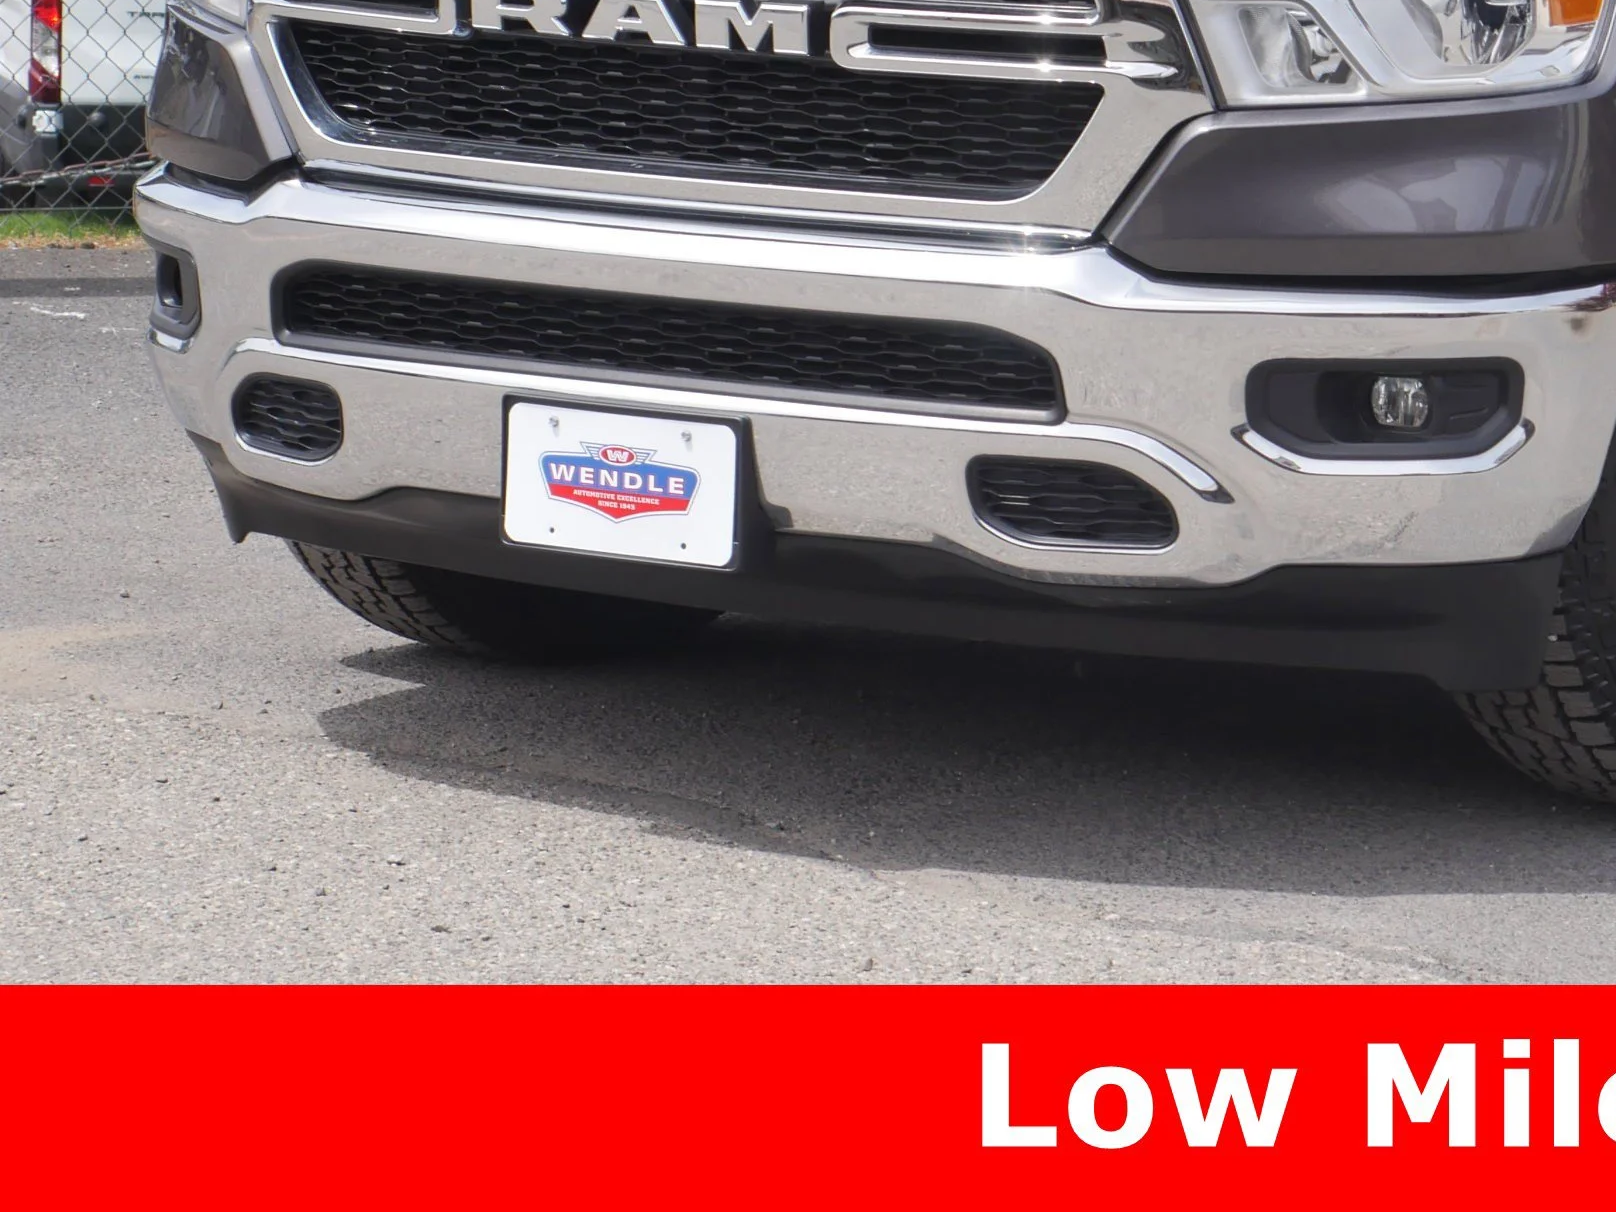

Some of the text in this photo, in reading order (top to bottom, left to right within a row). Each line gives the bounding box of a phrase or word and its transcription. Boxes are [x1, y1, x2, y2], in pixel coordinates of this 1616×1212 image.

[550, 463, 684, 494] WENDLE
[573, 489, 660, 506] AUTOMOTIVE EXCELLENCE
[597, 500, 619, 509] SINCE
